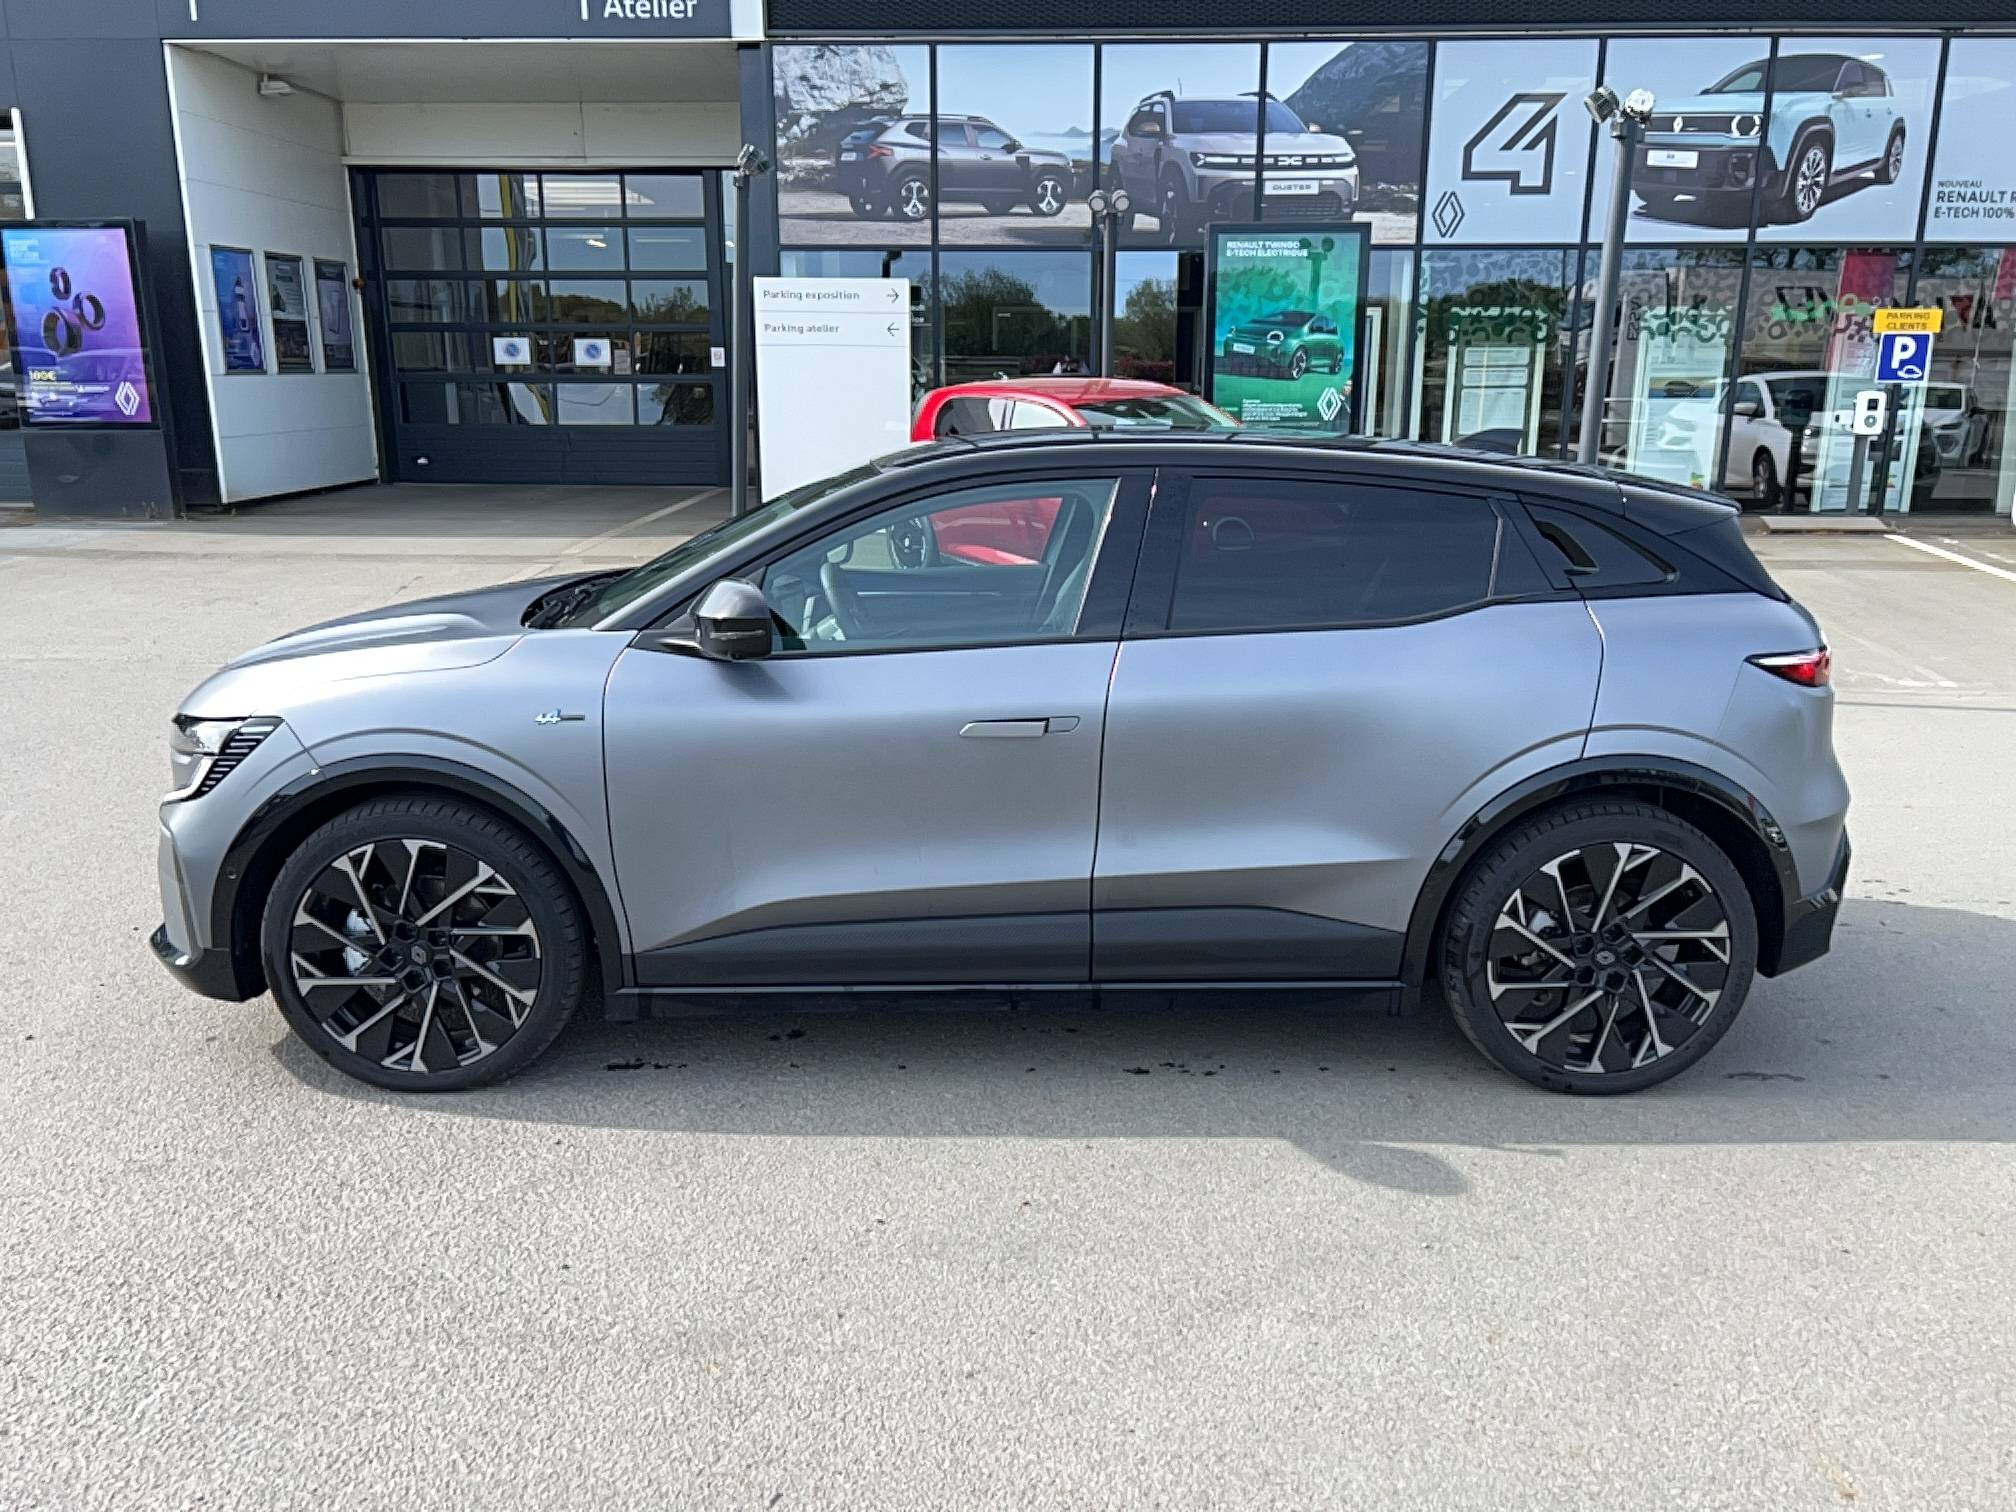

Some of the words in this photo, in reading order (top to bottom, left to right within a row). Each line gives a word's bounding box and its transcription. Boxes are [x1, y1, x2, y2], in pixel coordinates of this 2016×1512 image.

[603, 0, 698, 18] Atelier
[1461, 92, 1568, 195] 4
[1936, 190, 2008, 203] RENAULT
[1934, 206, 1980, 218] E-TECH
[1982, 206, 2015, 218] 100%
[1226, 240, 1264, 249] RENAULT
[1265, 240, 1300, 249] TWINGO
[763, 289, 802, 301] Parking
[805, 289, 860, 301] exposition
[1886, 312, 1930, 320] PARKING
[764, 323, 804, 334] Parking
[806, 323, 840, 333] atelier
[1886, 322, 1928, 330] CLIENTS
[1891, 335, 1917, 369] P
